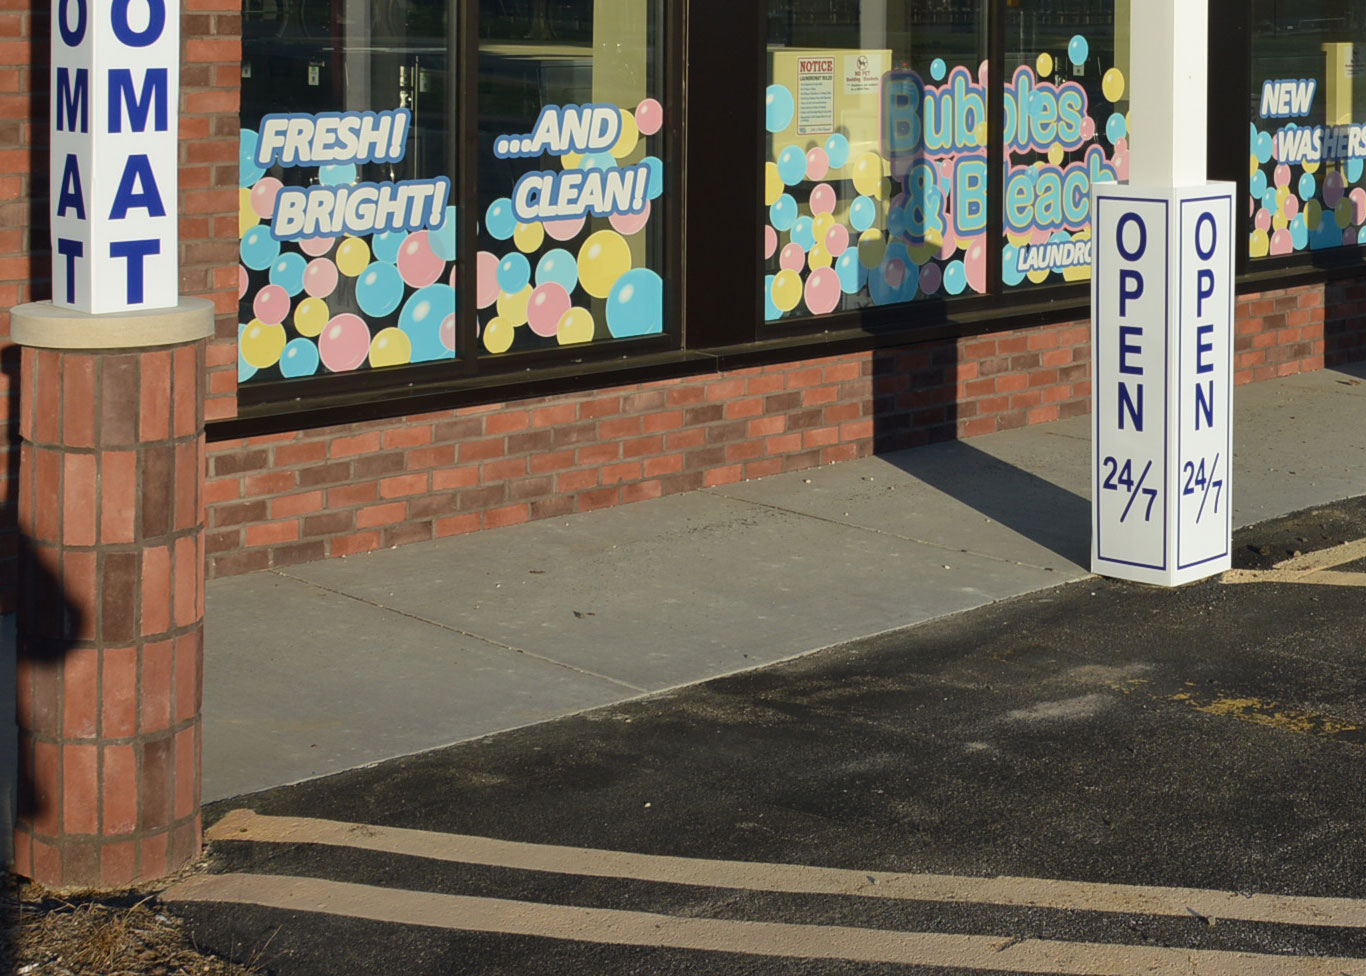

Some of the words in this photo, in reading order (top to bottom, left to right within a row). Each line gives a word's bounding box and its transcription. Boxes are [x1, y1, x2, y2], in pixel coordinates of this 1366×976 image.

[800, 60, 833, 73] NOTICE
[1261, 81, 1315, 115] NEW
[258, 112, 407, 164] FRESH!
[274, 180, 447, 237] BRIGHT!
[515, 166, 648, 219] CLEAN!
[903, 162, 944, 237] &
[1115, 211, 1148, 433] OPEN
[1194, 211, 1218, 432] OPEN
[1102, 456, 1158, 523] 24/7
[1183, 452, 1223, 524] 24/7
